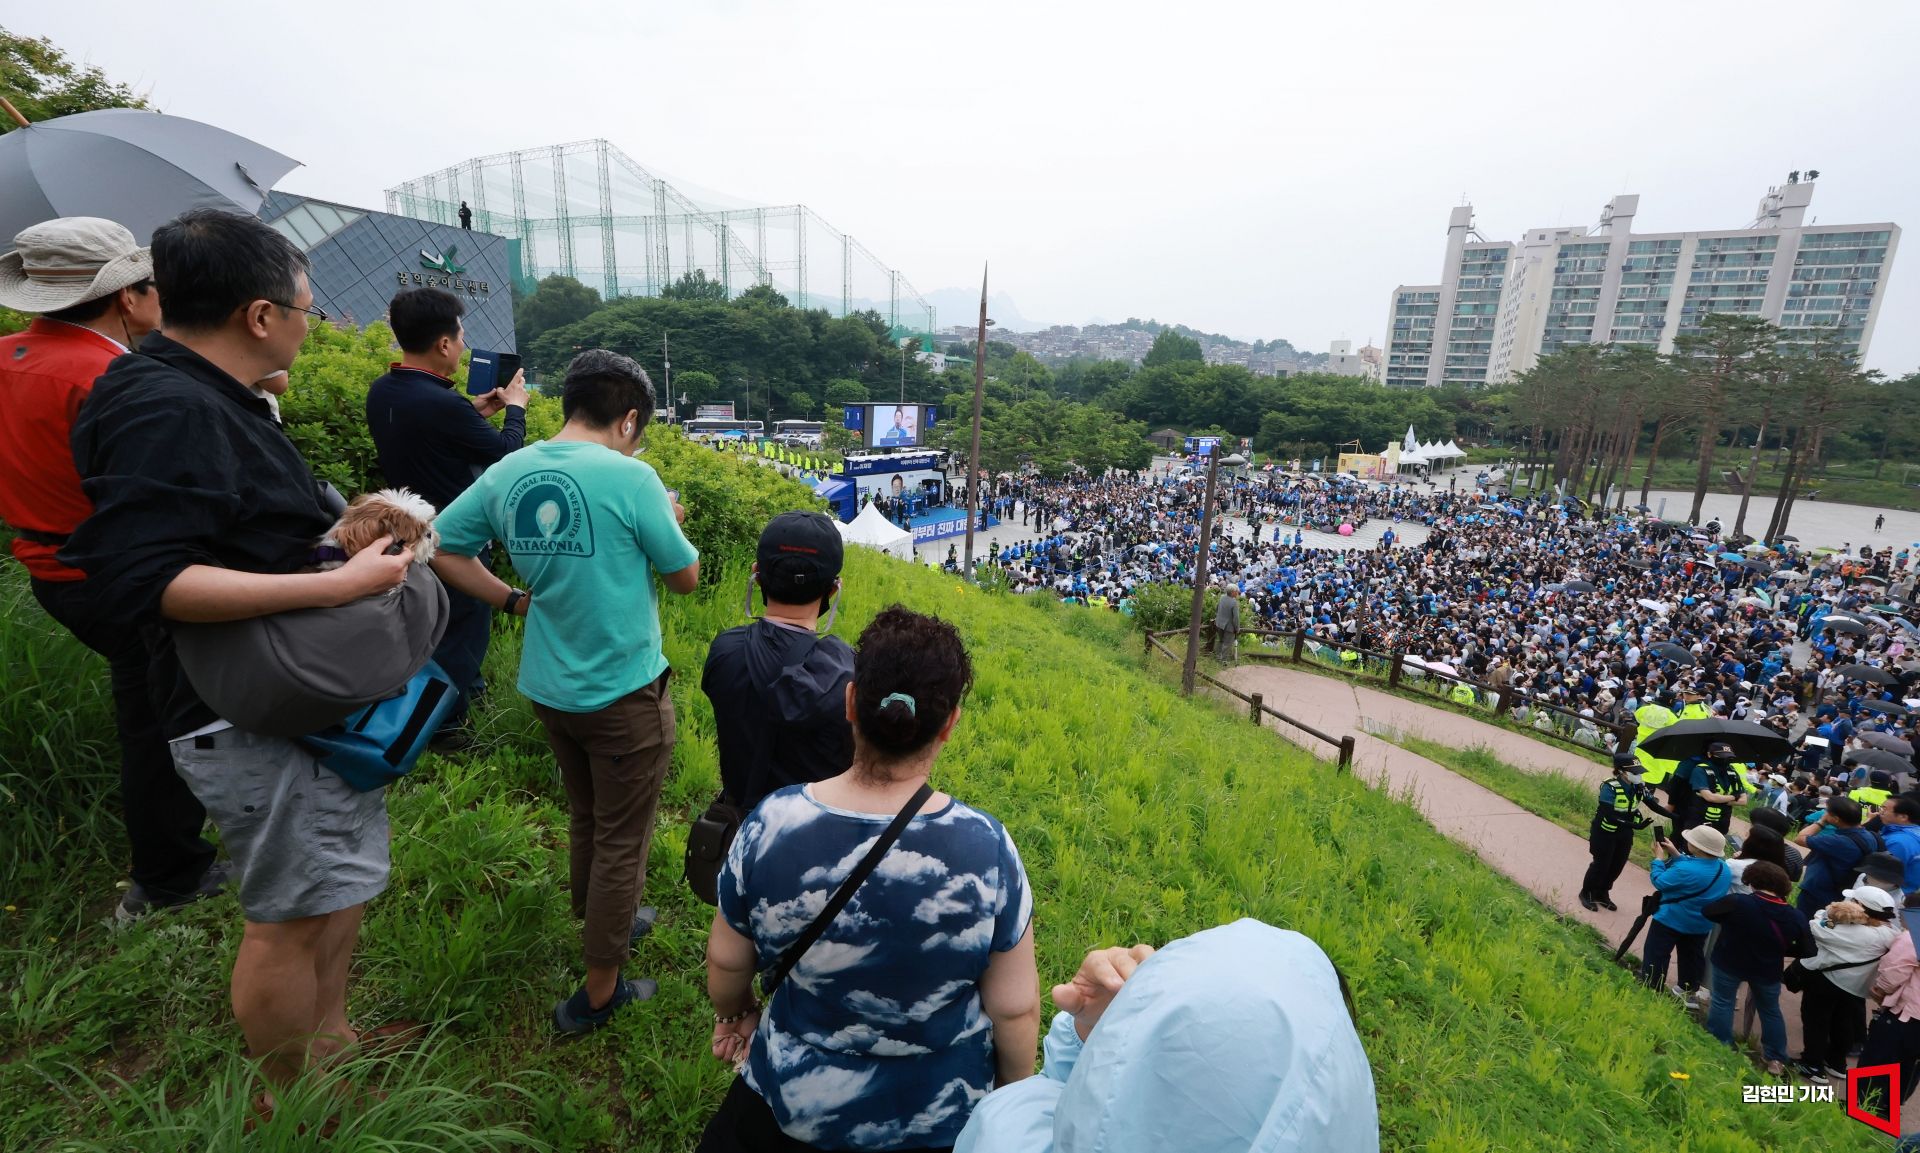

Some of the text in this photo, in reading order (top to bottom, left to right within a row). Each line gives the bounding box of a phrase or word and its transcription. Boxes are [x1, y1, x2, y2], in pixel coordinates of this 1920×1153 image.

[509, 474, 582, 539] NATURAL RUBBER WETSUITS
[509, 540, 585, 553] PATAGONIA
